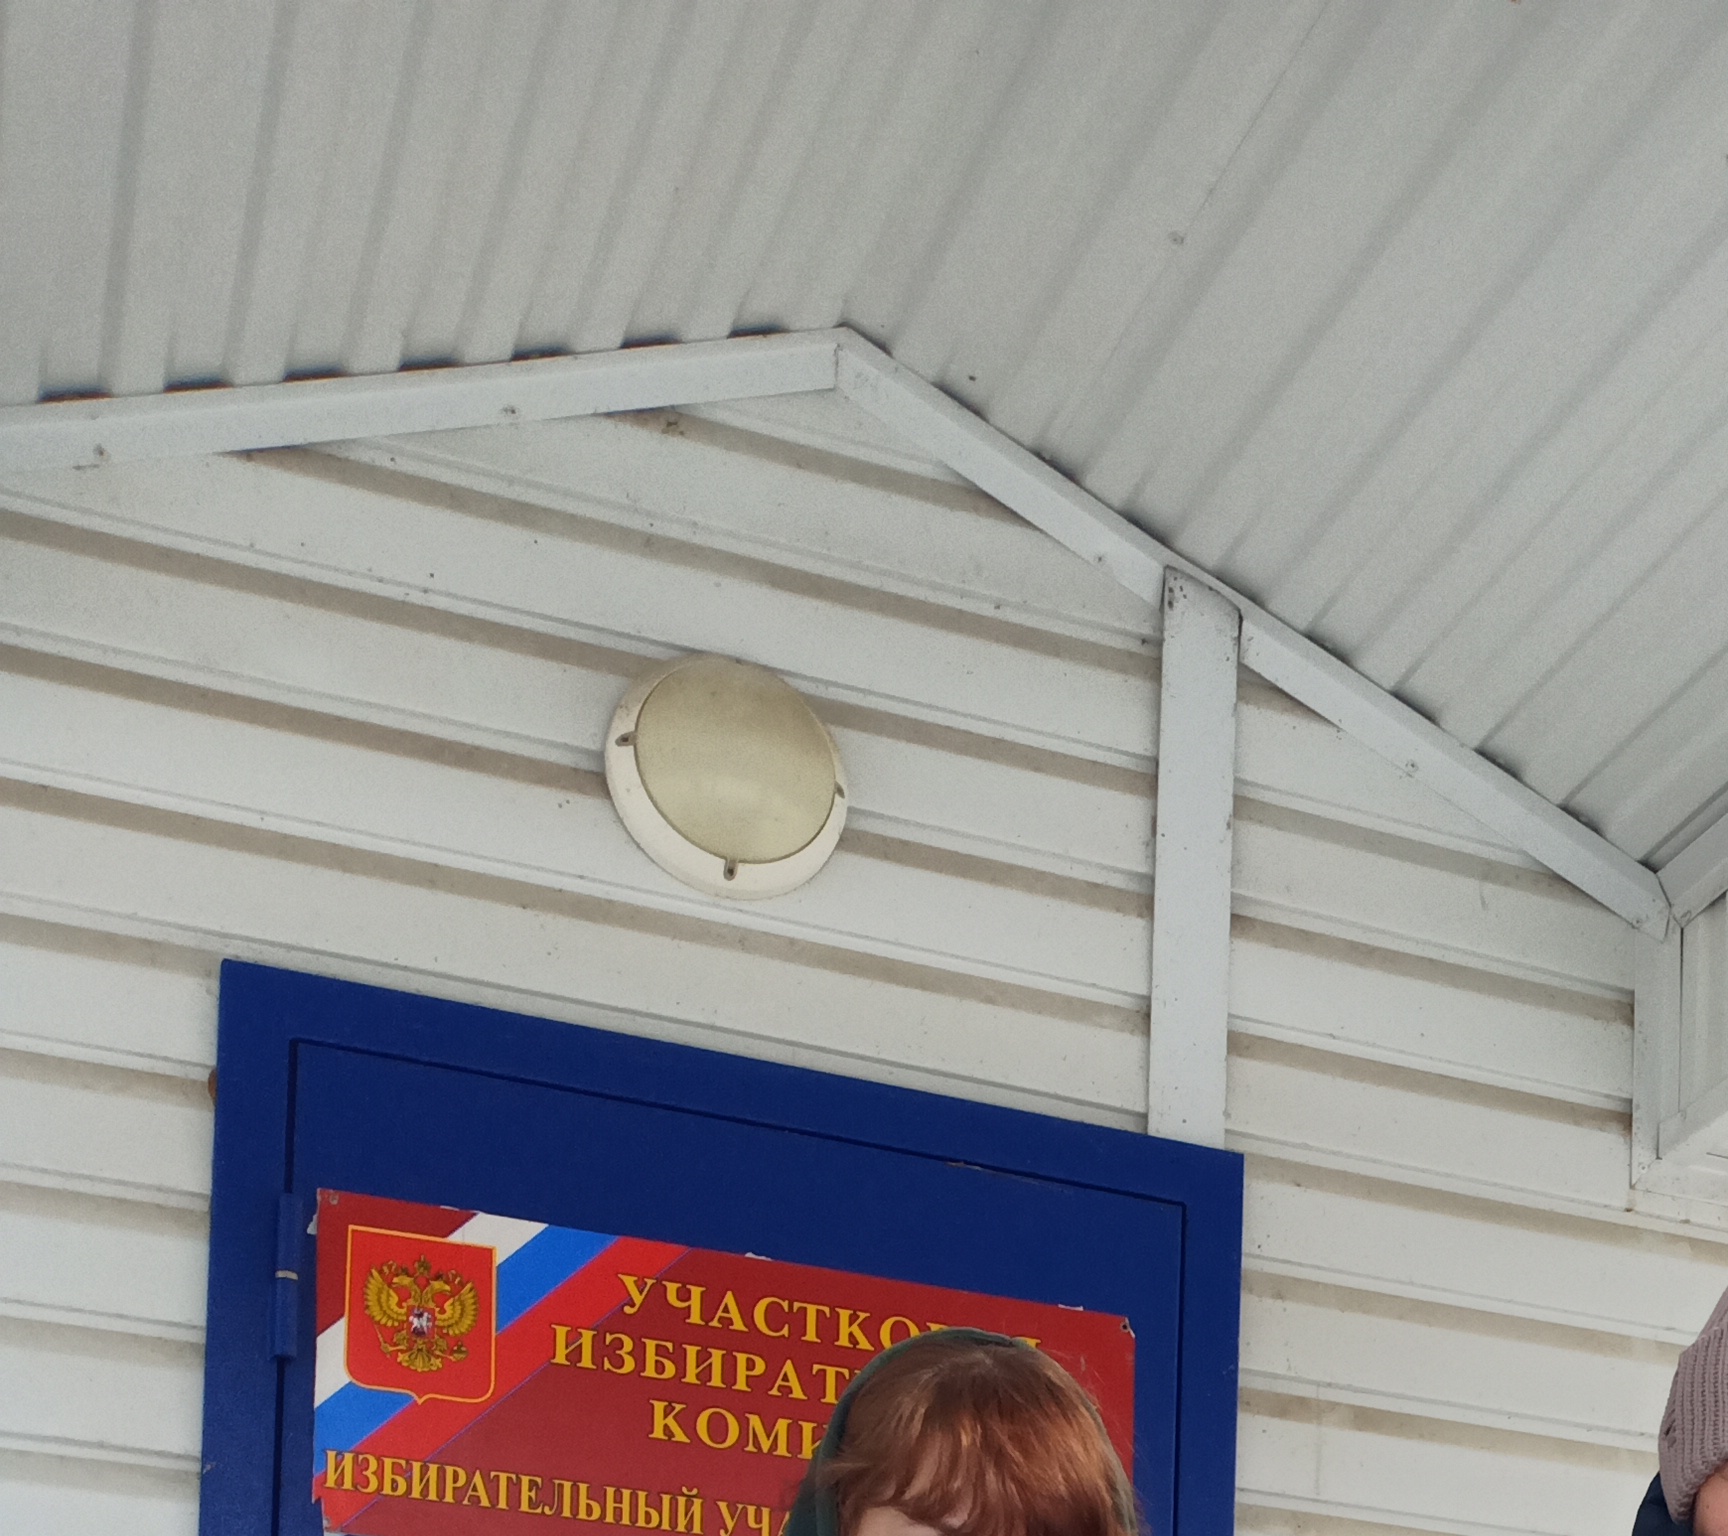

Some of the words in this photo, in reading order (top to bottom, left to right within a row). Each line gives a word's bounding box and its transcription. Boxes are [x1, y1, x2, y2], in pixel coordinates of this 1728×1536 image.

[617, 1274, 1041, 1351] УЧАСТКО
[551, 1325, 859, 1404] ИЗБИРАТ
[649, 1400, 828, 1460] КОМИ
[325, 1450, 704, 1536] ИЗБИРАТЕЛЬНЫЙ
